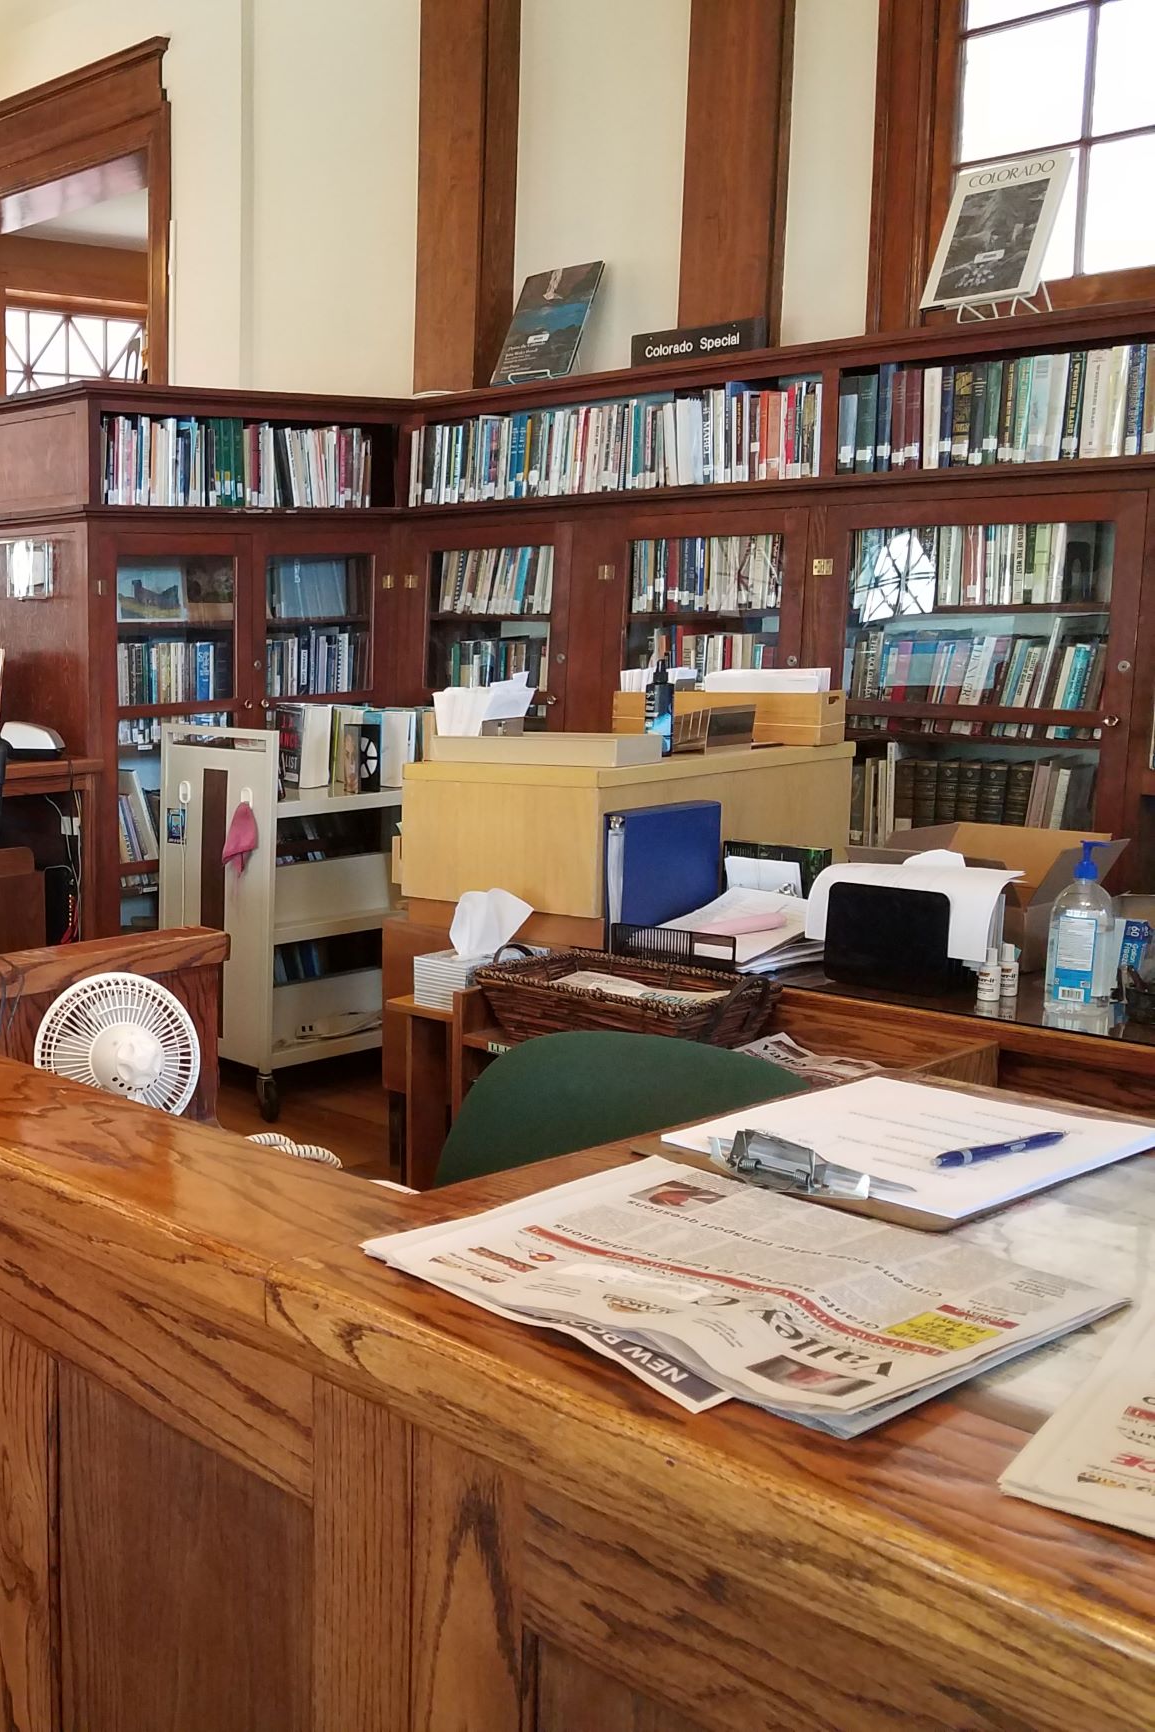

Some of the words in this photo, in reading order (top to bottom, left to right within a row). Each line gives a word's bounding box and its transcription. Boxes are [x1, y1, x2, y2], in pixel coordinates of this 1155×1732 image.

[968, 159, 1056, 188] COLORADO
[644, 340, 694, 358] Colorado
[699, 331, 741, 352] Special
[286, 755, 298, 771] LIST
[625, 1199, 700, 1225] questions
[553, 1222, 659, 1259] oranizations
[700, 1222, 775, 1248] transport
[777, 1243, 822, 1258] water
[826, 1252, 871, 1266] pose
[662, 1257, 711, 1272] Valley
[738, 1270, 817, 1295] awarded
[873, 1264, 943, 1298] Citizens
[817, 1294, 881, 1331] Grants
[747, 1308, 894, 1378] Valley
[622, 1342, 690, 1385] NEW
